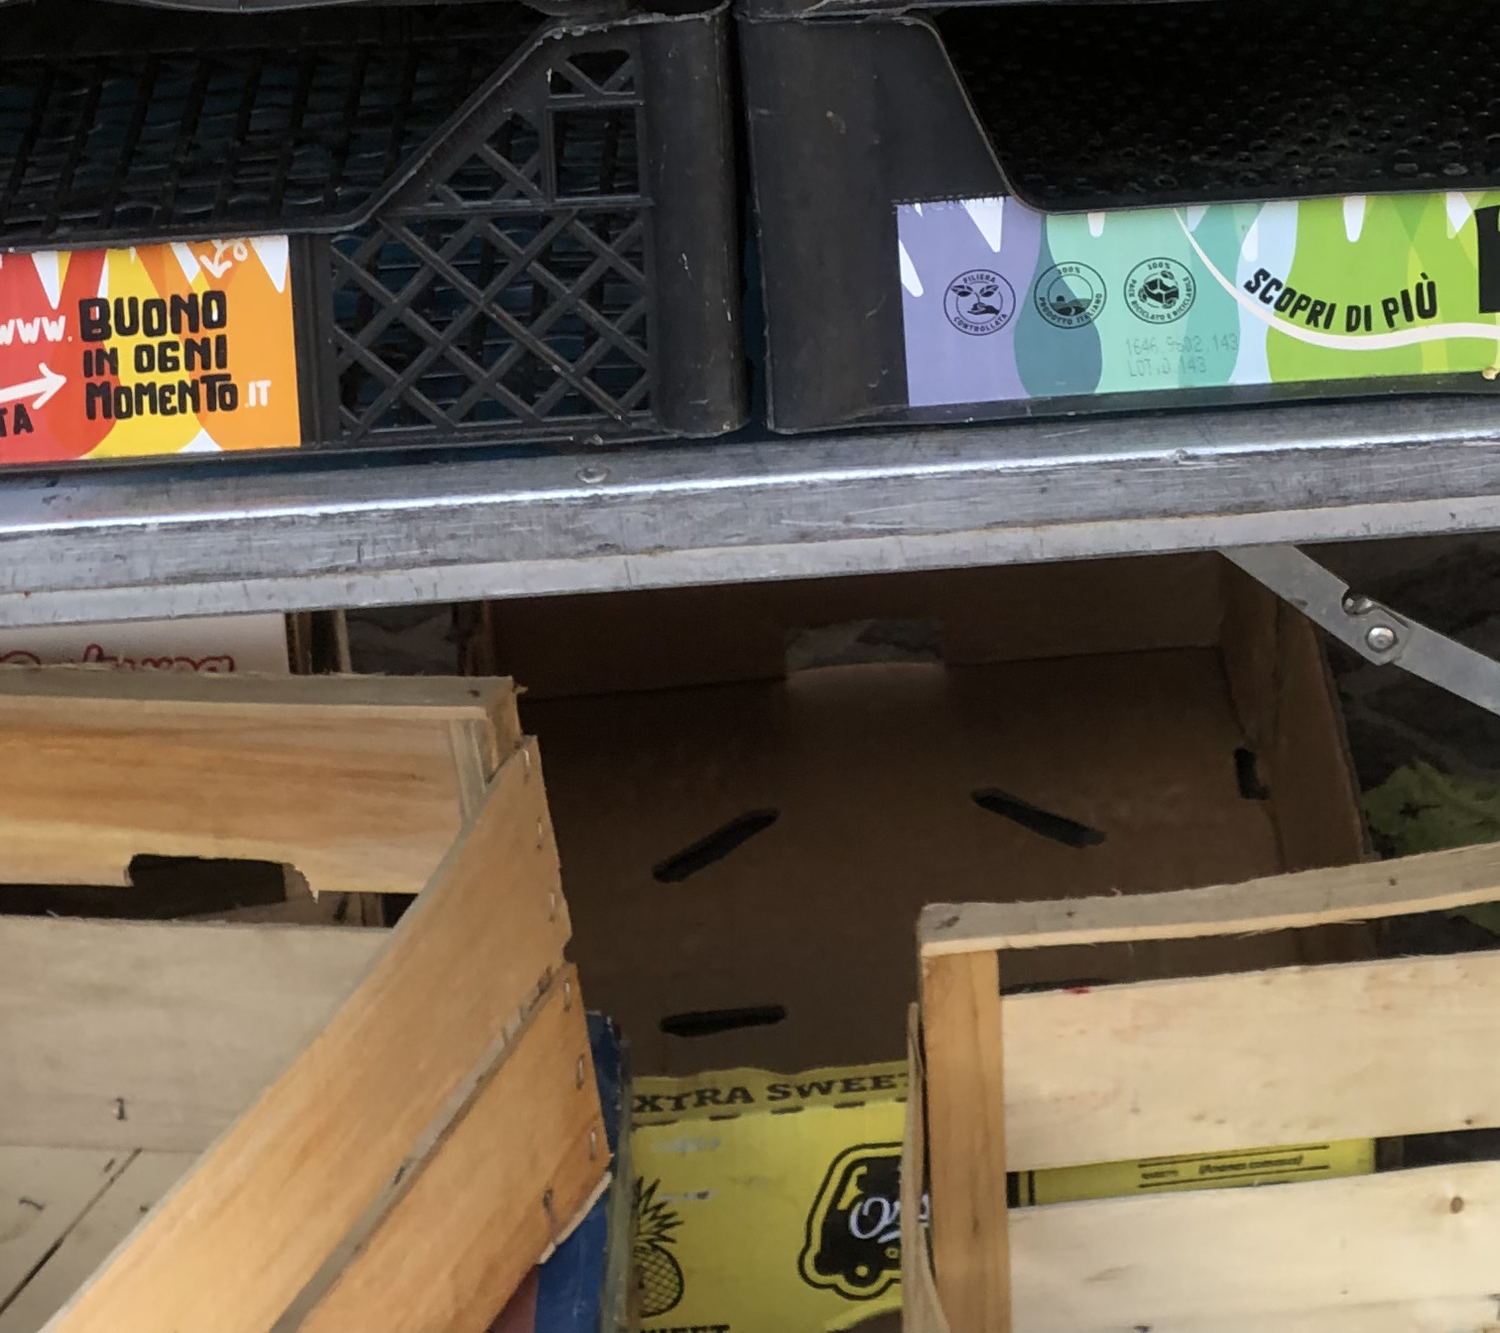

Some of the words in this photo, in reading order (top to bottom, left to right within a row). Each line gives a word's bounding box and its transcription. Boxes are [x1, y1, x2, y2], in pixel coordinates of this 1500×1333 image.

[962, 274, 996, 285] FILIERA
[1057, 266, 1081, 275] 100%
[1147, 261, 1171, 270] 100%
[79, 290, 227, 342] BUONO
[1243, 267, 1336, 331] SCOPRI
[1345, 304, 1372, 332] DI
[1384, 272, 1438, 329] PIÙ
[953, 313, 1008, 332] CONTROLLATA
[83, 347, 119, 378] IN
[134, 334, 228, 373] OGNI
[86, 374, 238, 421] MOMENTO
[632, 1085, 755, 1114] XTRA
[766, 1072, 908, 1102] SWEE
